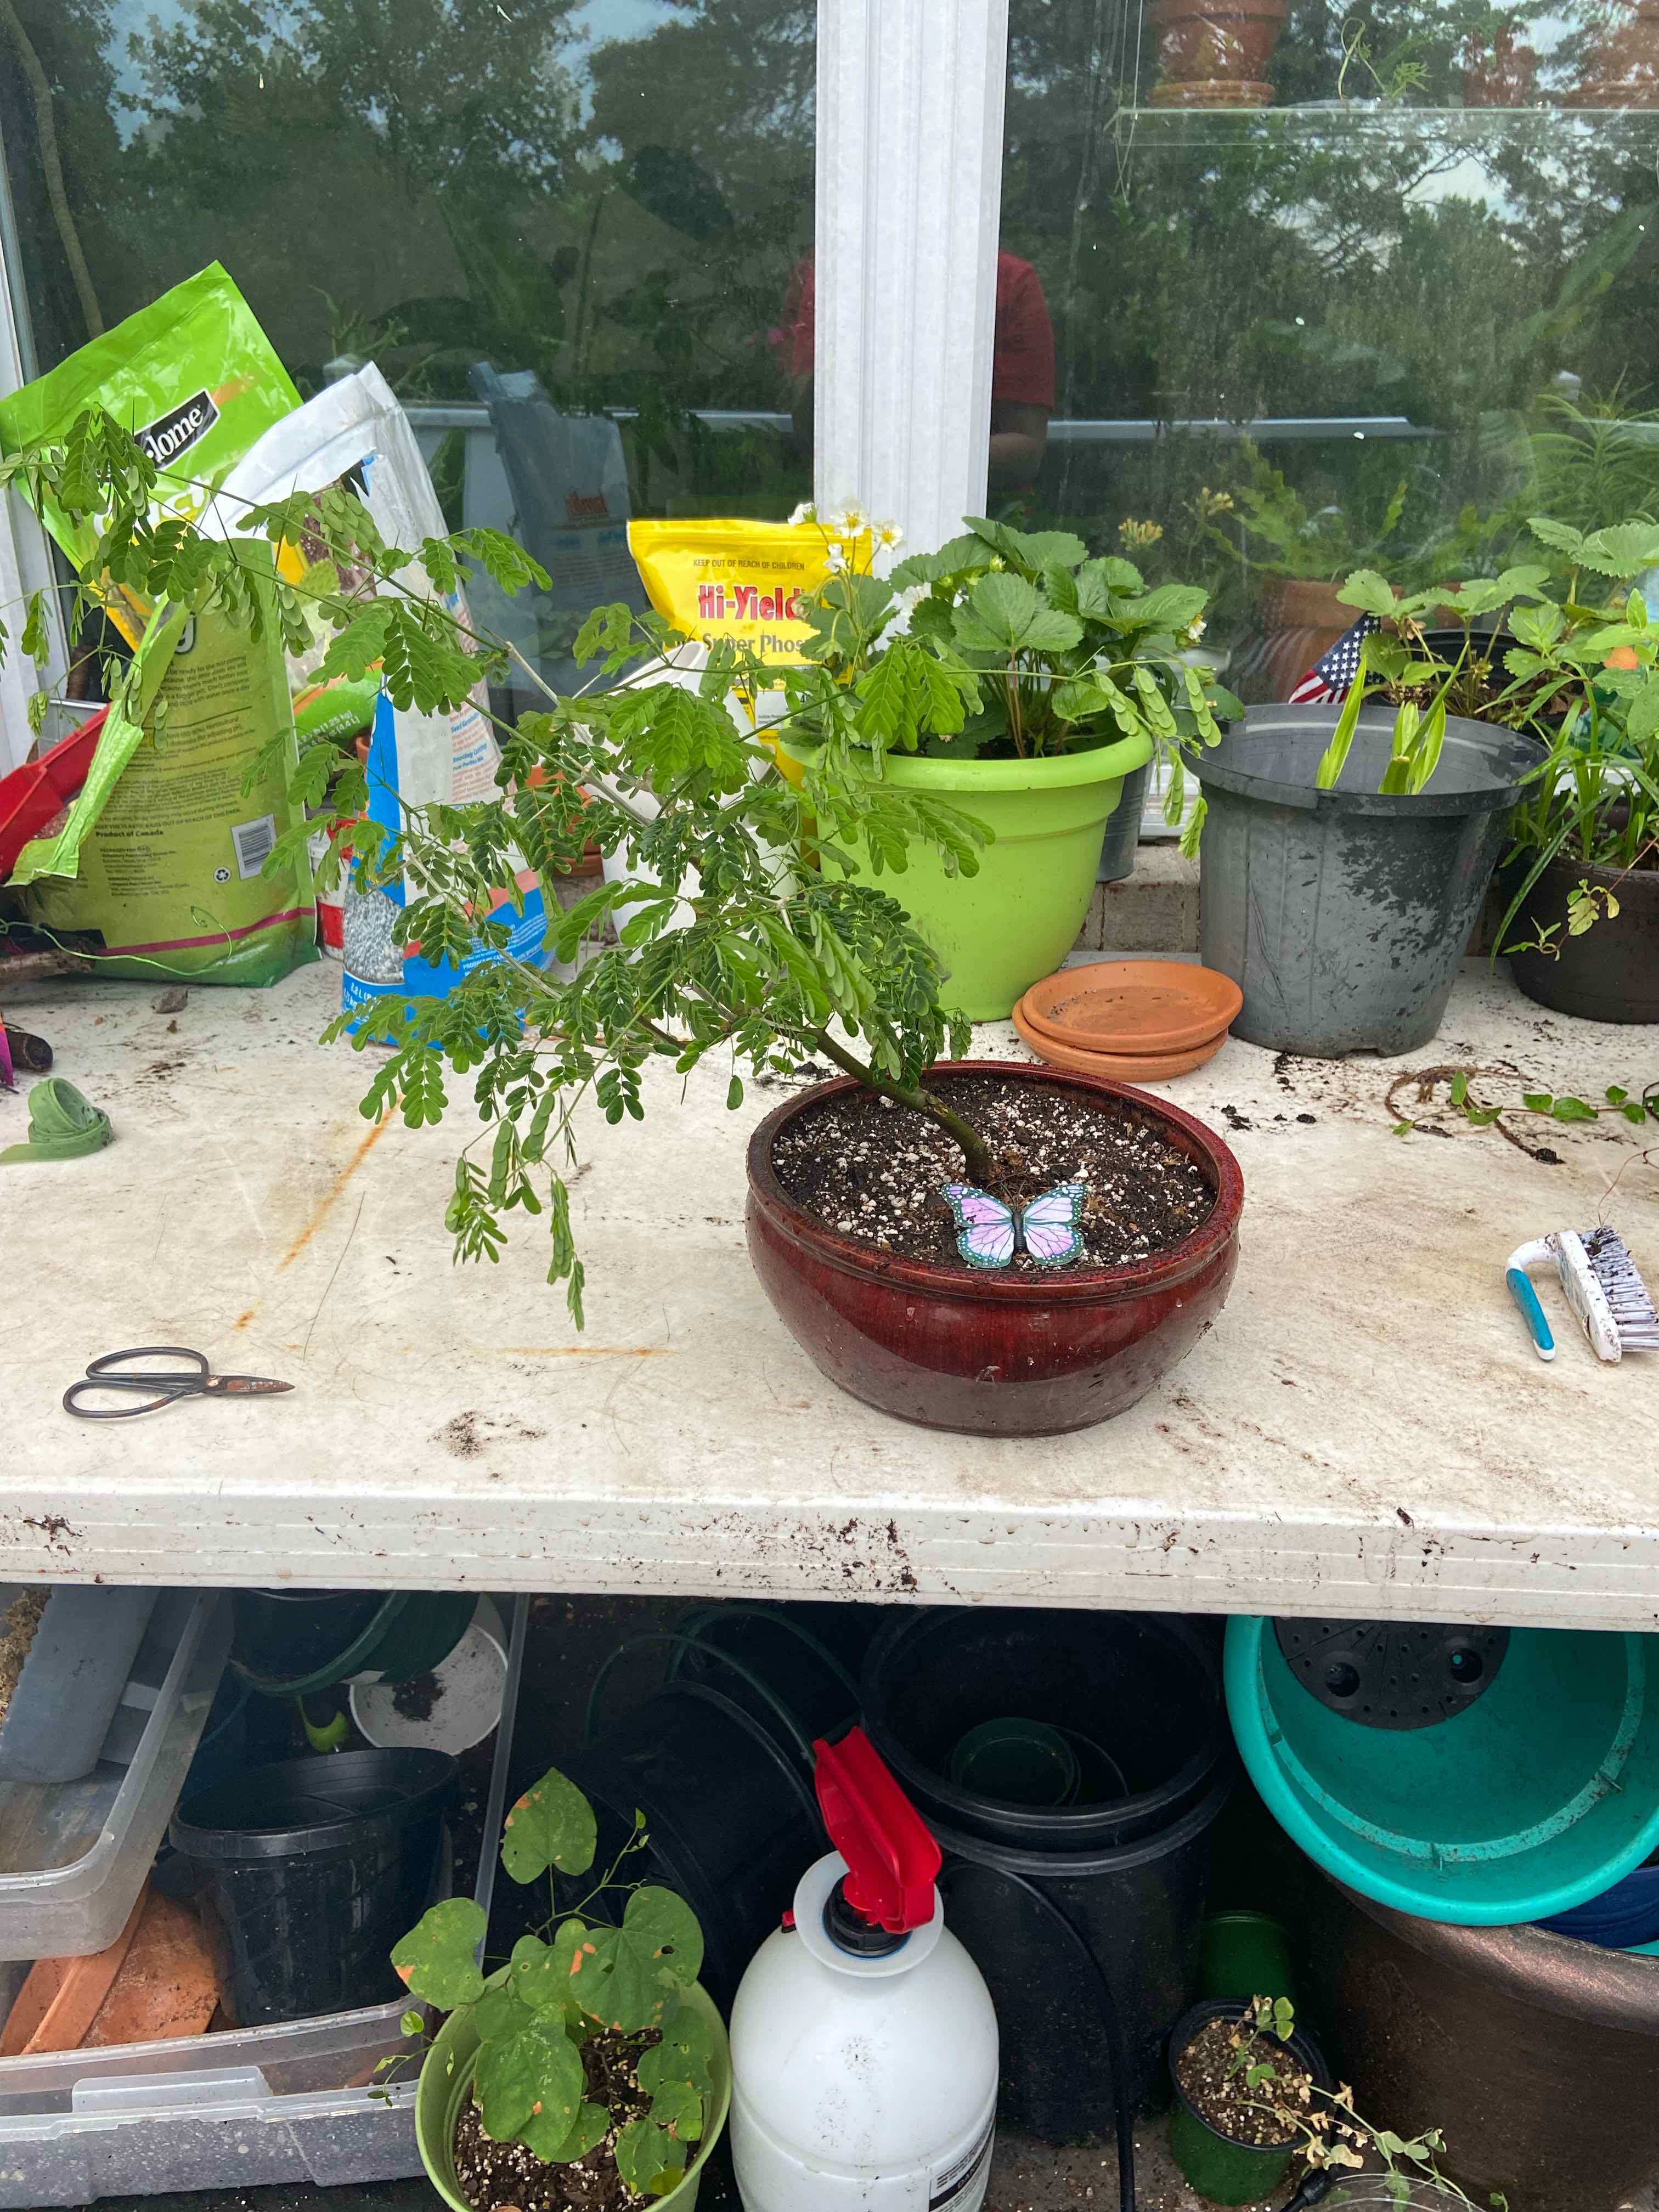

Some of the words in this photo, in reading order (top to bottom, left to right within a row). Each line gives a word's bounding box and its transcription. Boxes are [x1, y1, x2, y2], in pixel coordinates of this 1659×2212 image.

[712, 559, 725, 567] OUT
[727, 560, 736, 568] OF
[738, 560, 760, 568] REACH
[772, 561, 805, 571] CHILDREN
[698, 584, 801, 621] Hi-Yield
[136, 828, 164, 837] Canada
